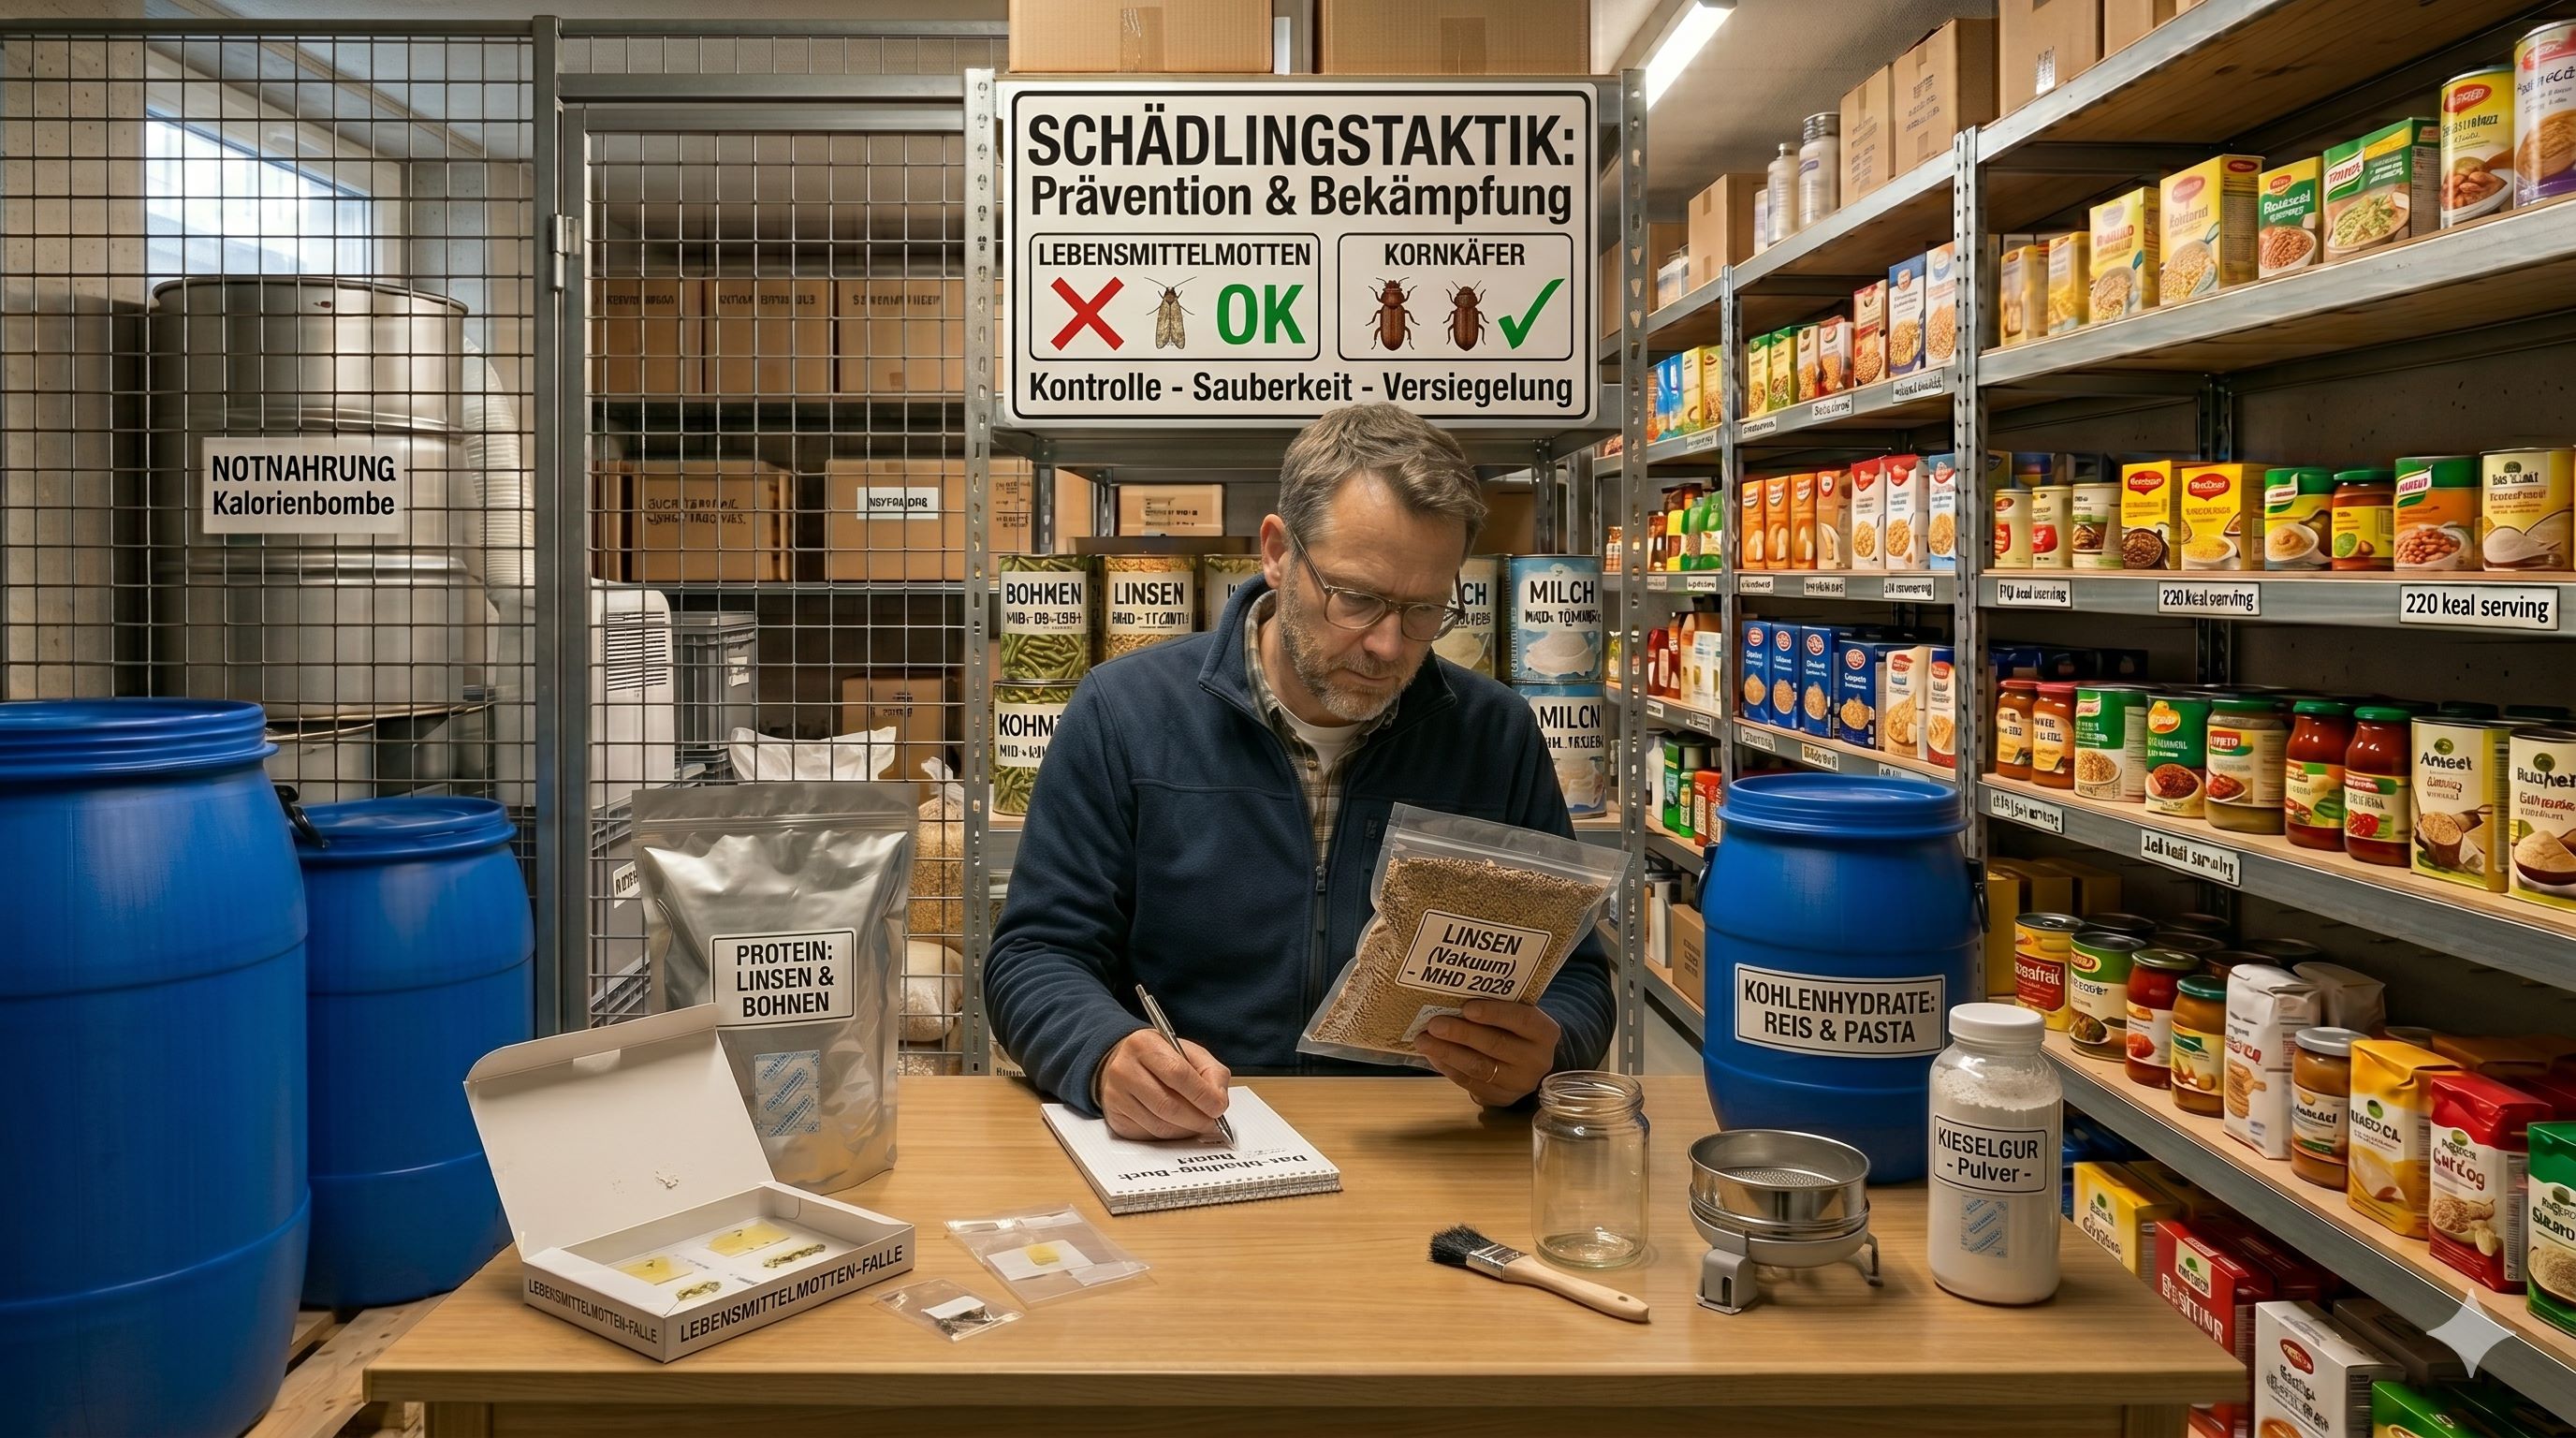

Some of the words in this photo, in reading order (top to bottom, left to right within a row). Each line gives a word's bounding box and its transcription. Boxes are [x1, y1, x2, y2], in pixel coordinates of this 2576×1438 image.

[1027, 103, 1576, 167] SCHÄDLINGSTAKTIK:
[1031, 175, 1252, 216] Prävention
[1265, 175, 1297, 216] &
[1310, 175, 1573, 225] Bekämpfung
[1038, 242, 1311, 268] LEBENSMITTELMOTTEN
[1383, 238, 1526, 268] KORNKÄFER
[1216, 284, 1307, 345] OK
[1030, 372, 1163, 403] Kontrolle
[1193, 372, 1353, 403] Sauberkeit
[1383, 372, 1573, 408] Versiegelung
[212, 455, 396, 482] NOTNAHRUNG
[212, 491, 395, 515] Kalorienbombe
[1114, 582, 1184, 606] LINSEN
[1530, 580, 1595, 604] MILCH
[2406, 593, 2437, 614] 220
[2481, 595, 2549, 624] serving
[998, 713, 1061, 737] KOHM
[736, 940, 833, 966] PROTEIN:
[1442, 923, 1523, 956] LINSEN
[1427, 946, 1517, 978] (Vakuum)
[736, 968, 812, 991] LINSEN
[817, 966, 835, 986] &
[1420, 966, 1467, 988] MHD
[1468, 976, 1515, 996] 2028
[742, 991, 829, 1018] BOHNEN
[1744, 978, 1936, 1015] KOHLENHYDRATE:
[1764, 1011, 1813, 1038] REIS
[1819, 1020, 1837, 1041] &
[1844, 1020, 1916, 1045] PASTA
[1938, 1126, 2039, 1159] KIESELGUR
[1957, 1157, 2020, 1183] Pulver
[680, 1244, 903, 1343] LEBENSMITTELMOTTEN-FALLE
